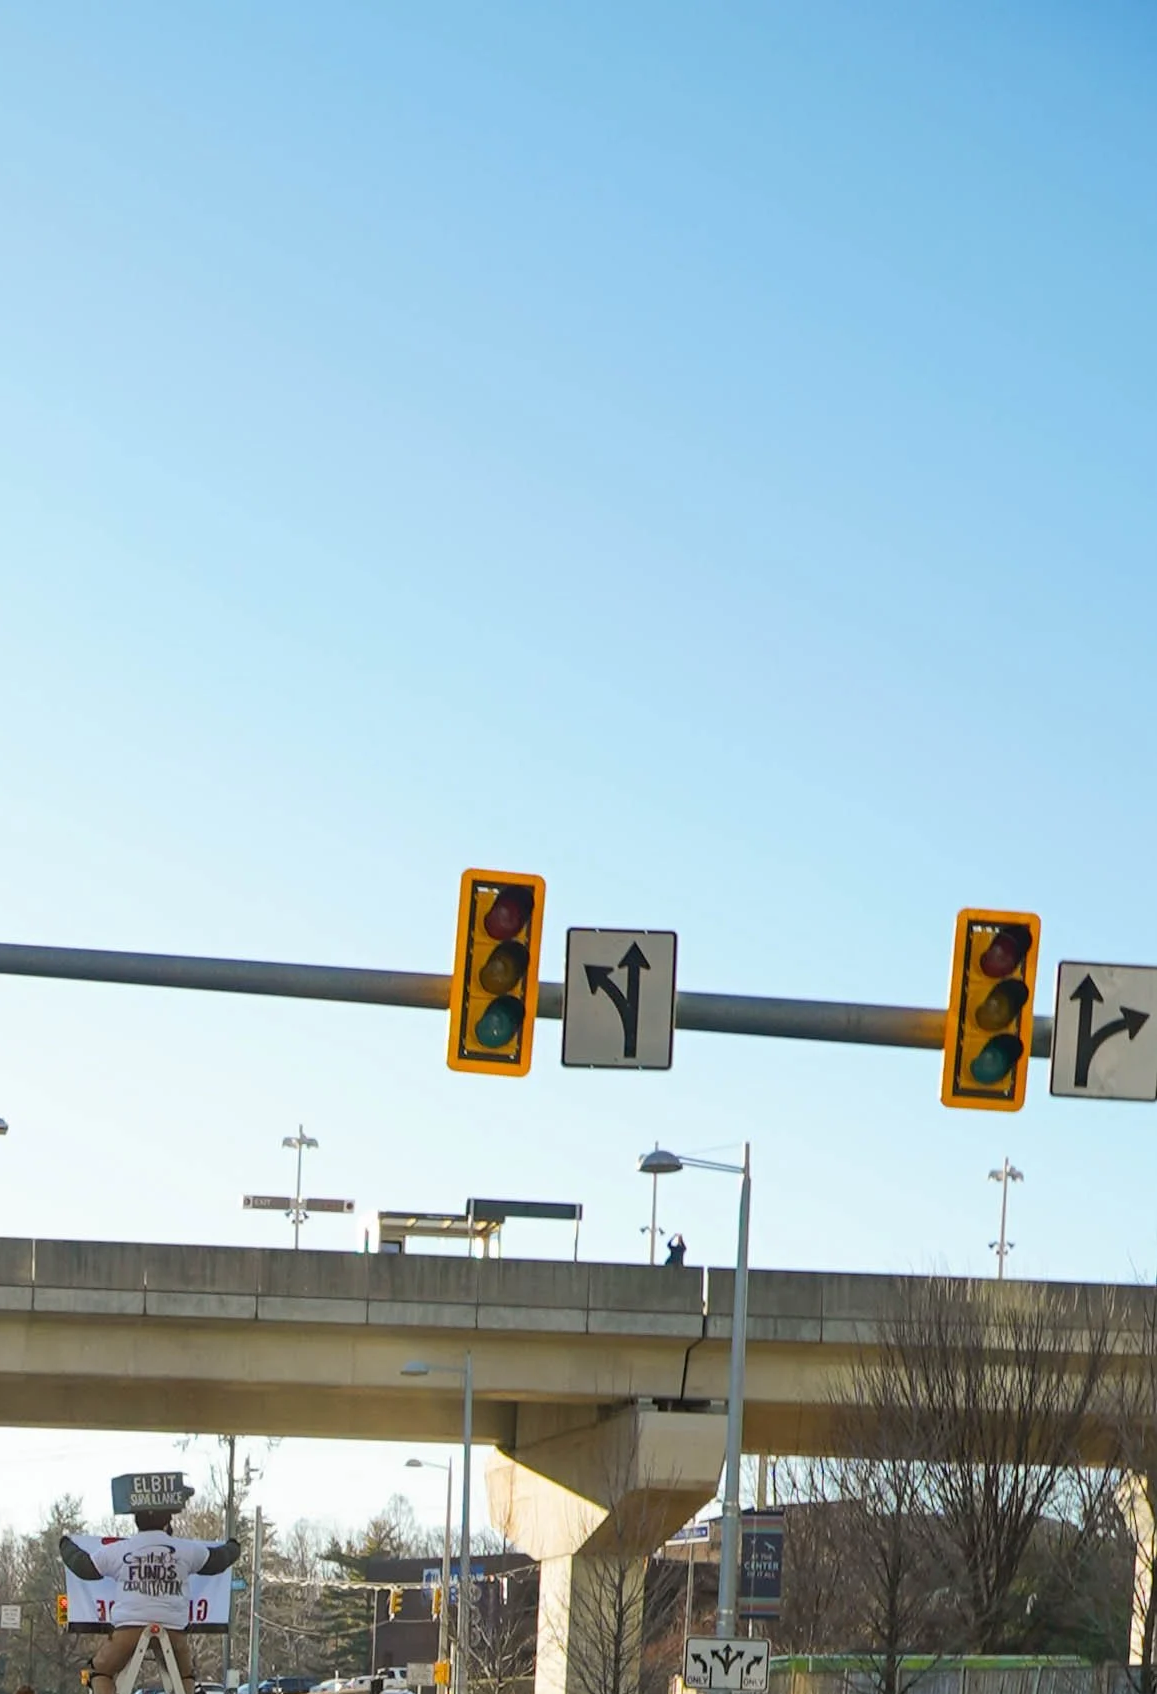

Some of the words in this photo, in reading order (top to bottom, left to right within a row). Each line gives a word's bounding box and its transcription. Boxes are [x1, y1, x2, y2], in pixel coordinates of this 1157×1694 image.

[134, 1475, 176, 1493] ELBIT
[744, 1561, 779, 1571] CENTER
[129, 1564, 177, 1580] FUNDS
[687, 1675, 708, 1685] ONLY
[743, 1677, 763, 1687] ONLY
